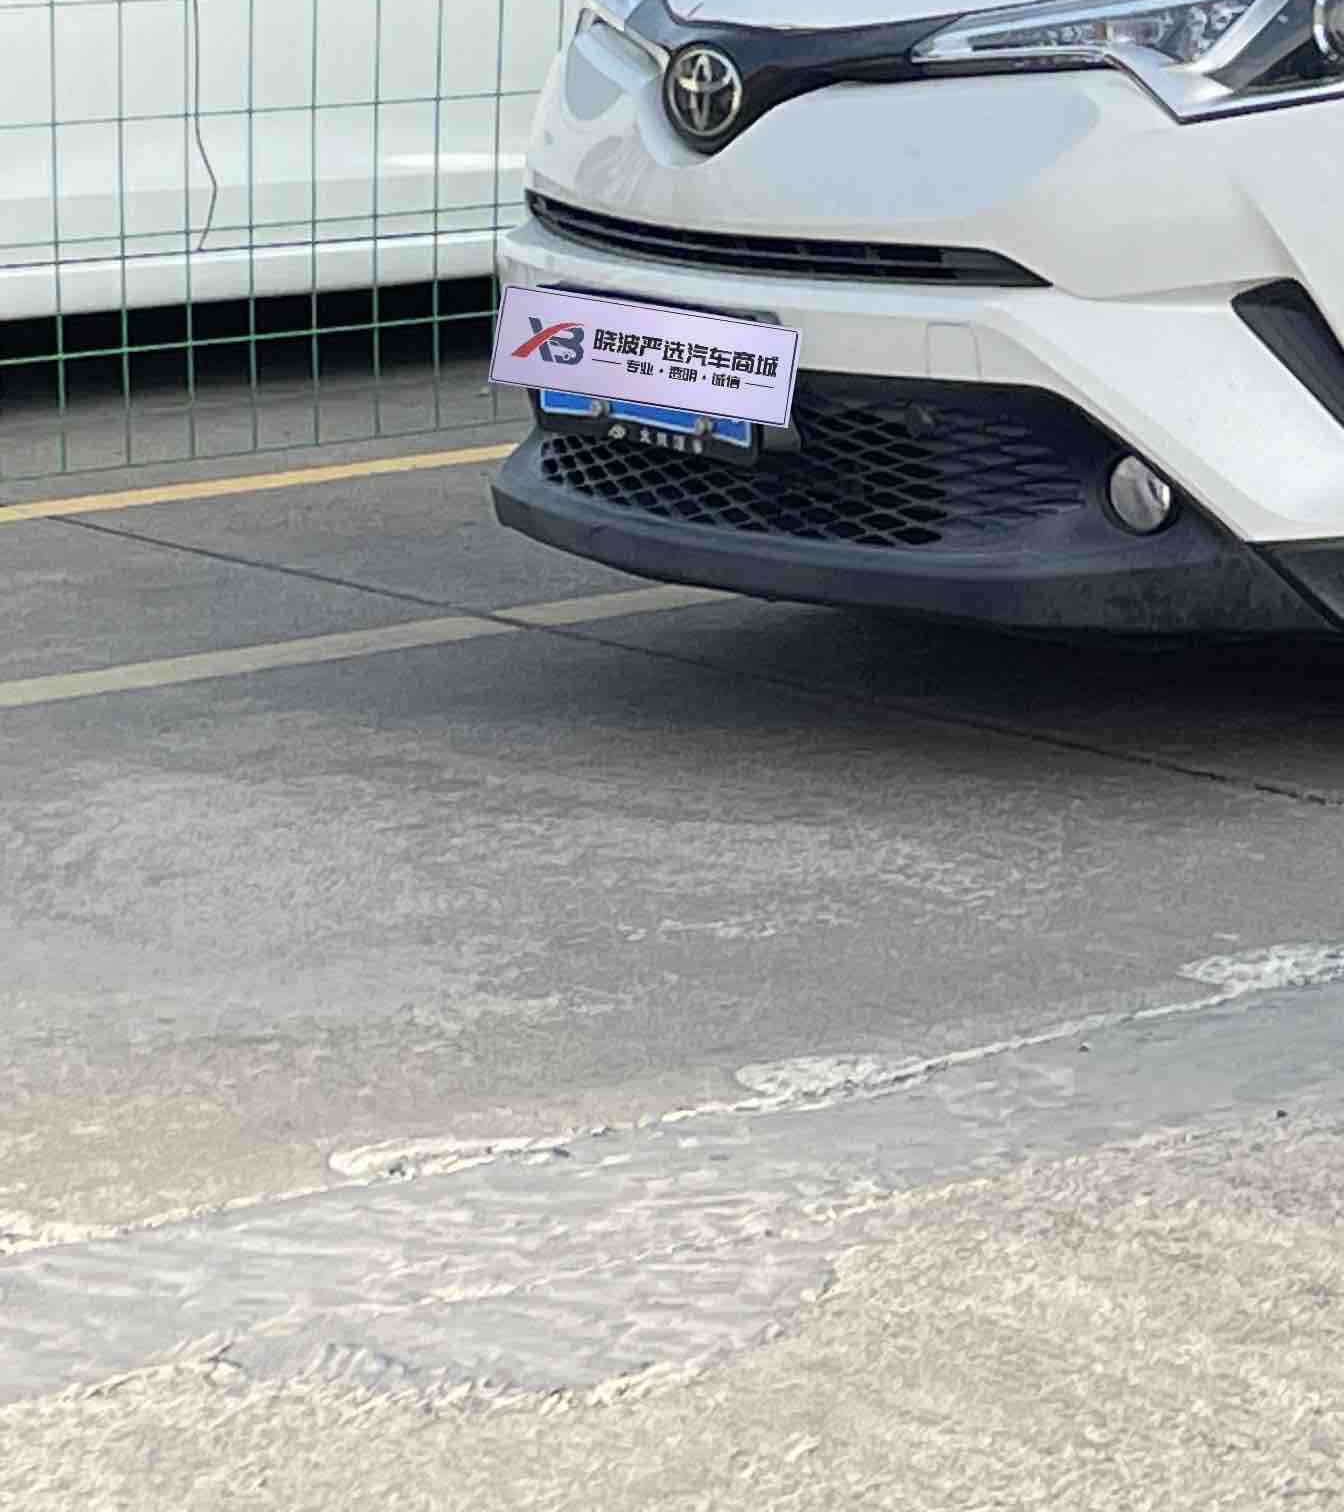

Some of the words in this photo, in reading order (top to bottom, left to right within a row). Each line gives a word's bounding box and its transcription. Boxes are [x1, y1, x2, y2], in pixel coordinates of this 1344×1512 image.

[592, 327, 780, 378] 晓波严选汽车商城
